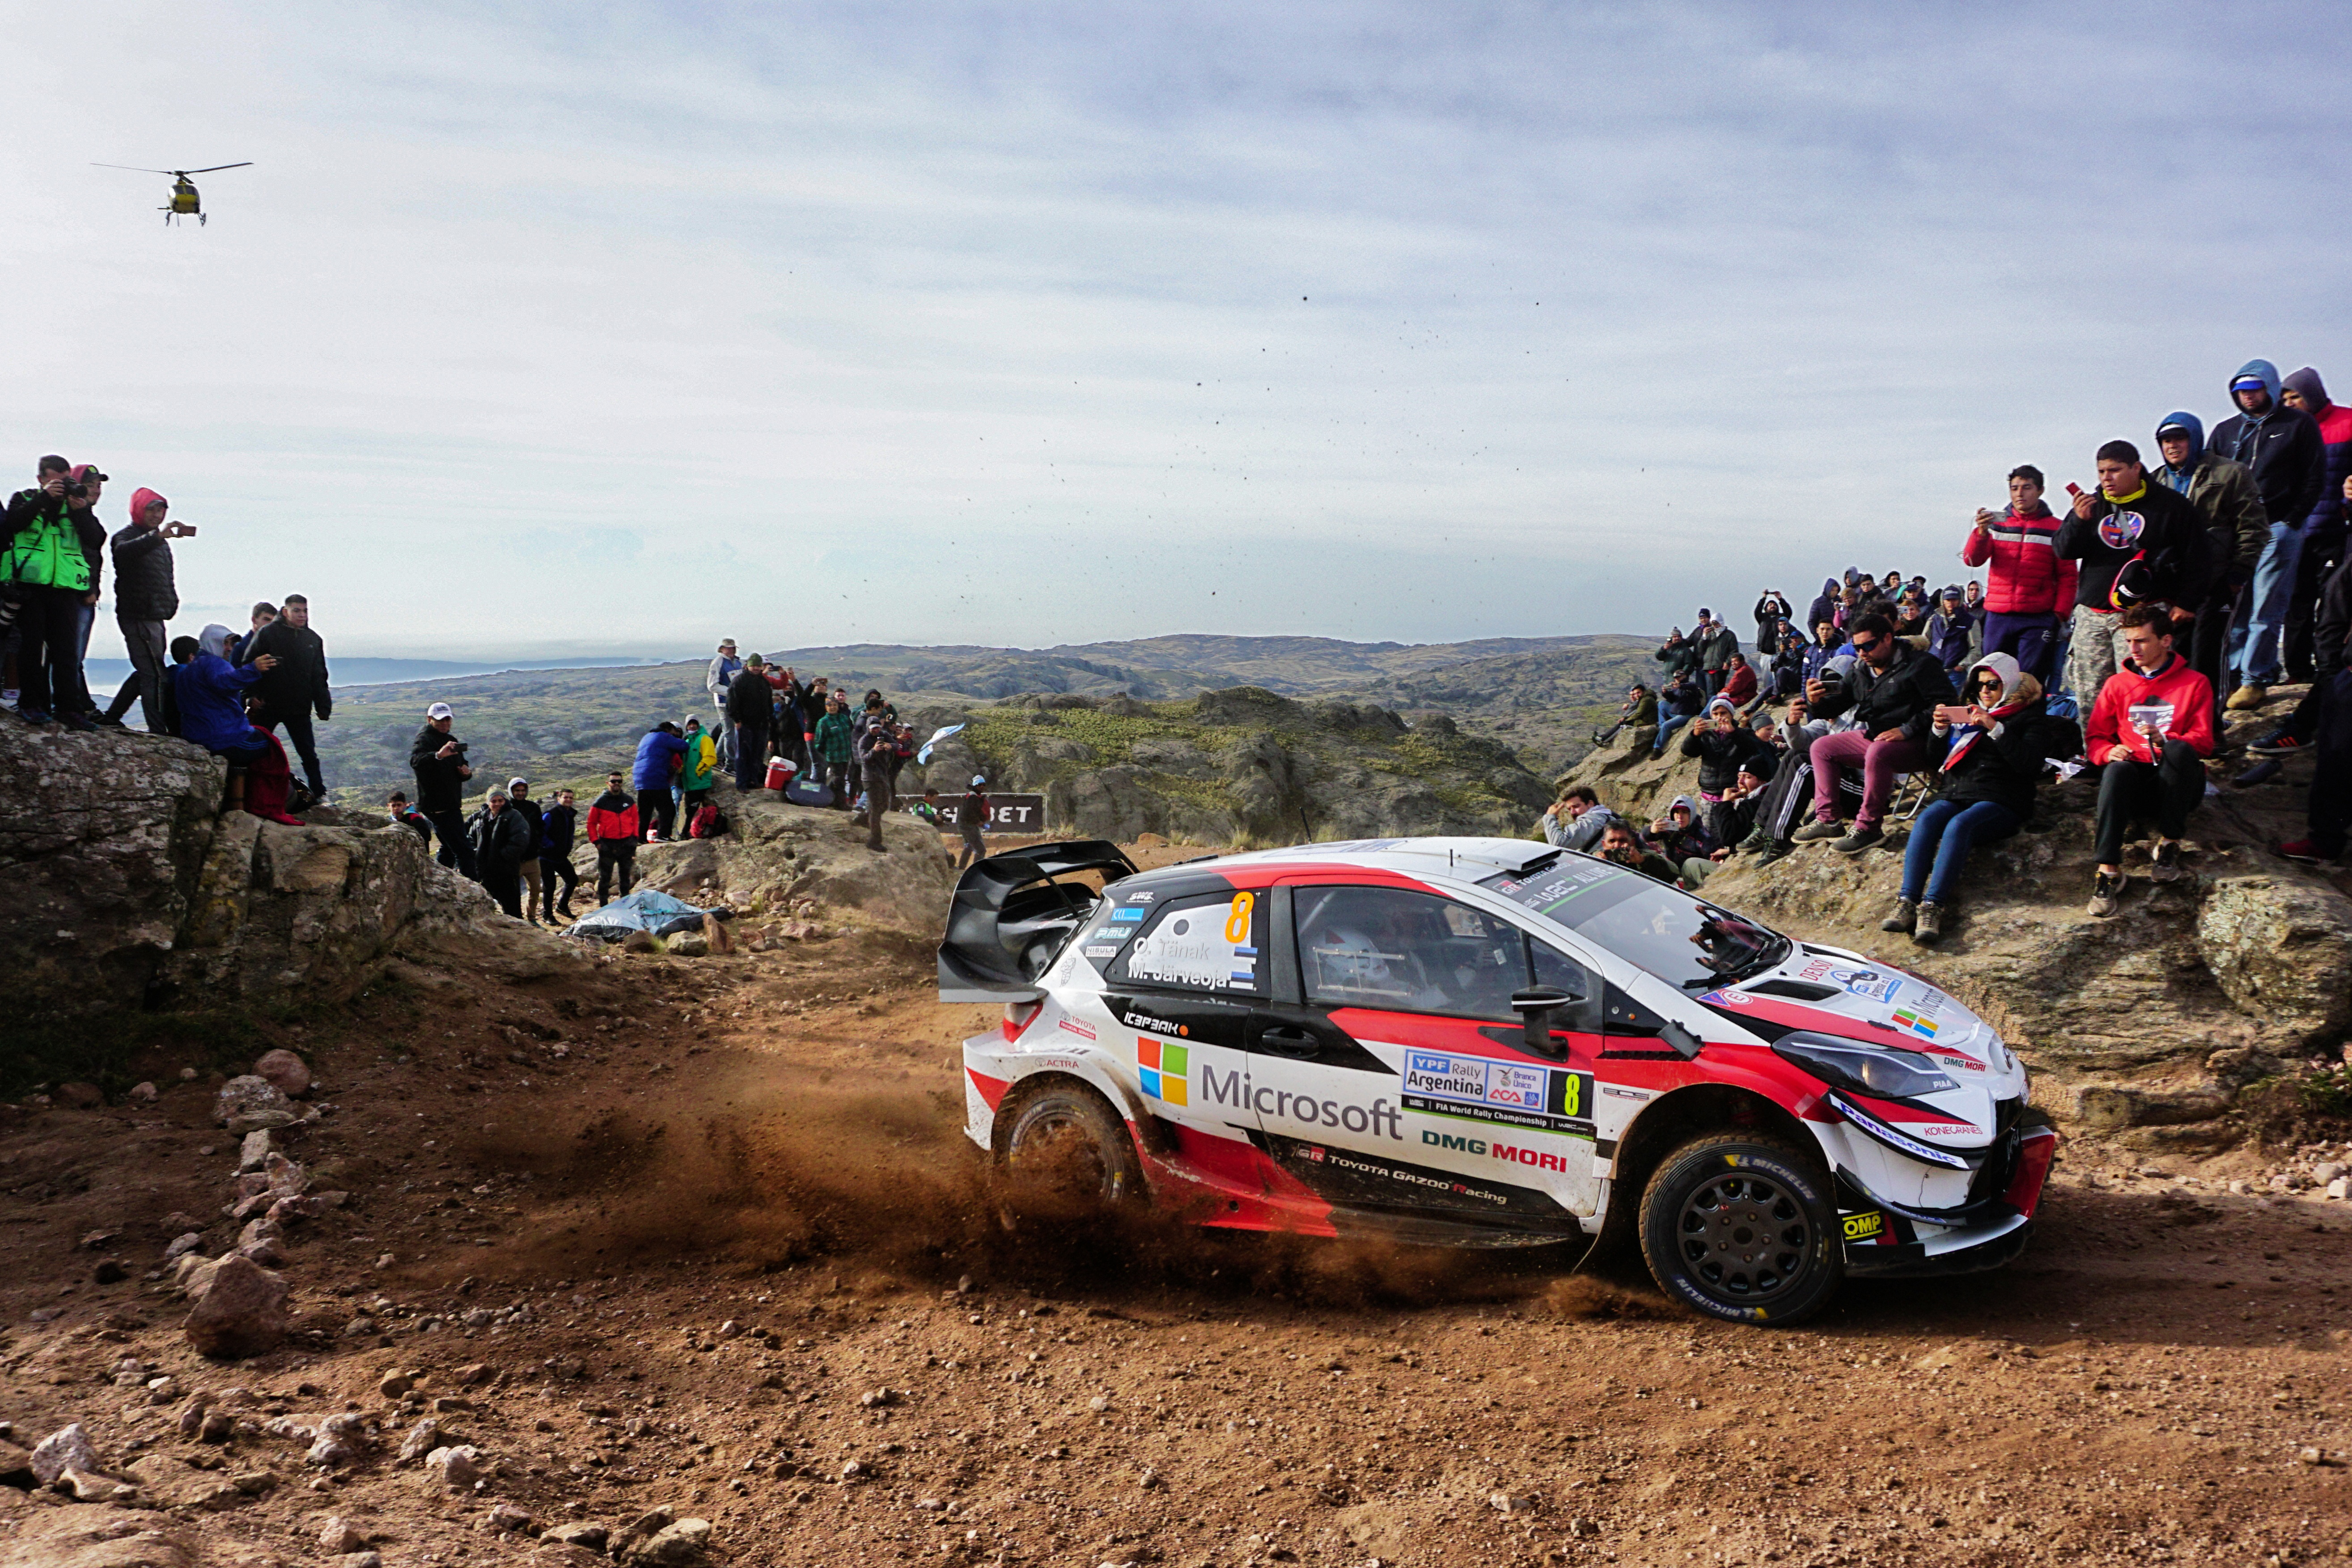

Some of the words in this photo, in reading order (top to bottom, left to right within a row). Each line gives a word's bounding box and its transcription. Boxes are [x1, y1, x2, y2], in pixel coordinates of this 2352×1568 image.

[1129, 892, 1154, 901] SWS
[1501, 883, 1522, 894] GR
[1225, 891, 1254, 943] 8
[1134, 937, 1151, 955] O.
[1159, 938, 1210, 960] Tänak
[1128, 962, 1148, 979] M.
[1153, 964, 1228, 990] Järveoja
[1799, 959, 1834, 981] DENSO
[1728, 993, 1745, 1001] E
[1060, 1021, 1078, 1033] FINANCIAL
[1078, 1029, 1095, 1039] SERVICES
[1072, 1016, 1096, 1032] TOYOTA
[1123, 1011, 1179, 1035] ICEPEAK
[1047, 1059, 1080, 1068] ACTRA
[1416, 1058, 1447, 1070] YPF
[1452, 1063, 1482, 1080] Rally
[1944, 1057, 1964, 1068] DMG
[1965, 1061, 1987, 1072] MORI
[1407, 1070, 1484, 1096] Argentina
[1514, 1071, 1537, 1081] Branca
[1933, 1079, 1953, 1089] PIAA
[1202, 1064, 1403, 1141] Microsoft
[1489, 1089, 1522, 1102] ACA
[1564, 1073, 1581, 1116] 8
[1436, 1102, 1448, 1112] FIA
[1450, 1104, 1472, 1115] World
[1474, 1109, 1493, 1119] Rally
[1494, 1111, 1547, 1127] Championship
[1840, 1102, 1958, 1164] Panasonic
[1924, 1126, 1983, 1136] KONECRANES
[1422, 1130, 1487, 1156] DMG
[1492, 1143, 1567, 1173] MORI
[1298, 1148, 1323, 1161] GR
[1329, 1155, 1389, 1177] TOYOTA
[1392, 1170, 1450, 1190] GAZOO
[1453, 1183, 1508, 1205] Racing
[1752, 1158, 1815, 1199] MICHELIN
[1843, 1215, 1882, 1236] OMP
[1676, 1278, 1741, 1317] MICHELIN
